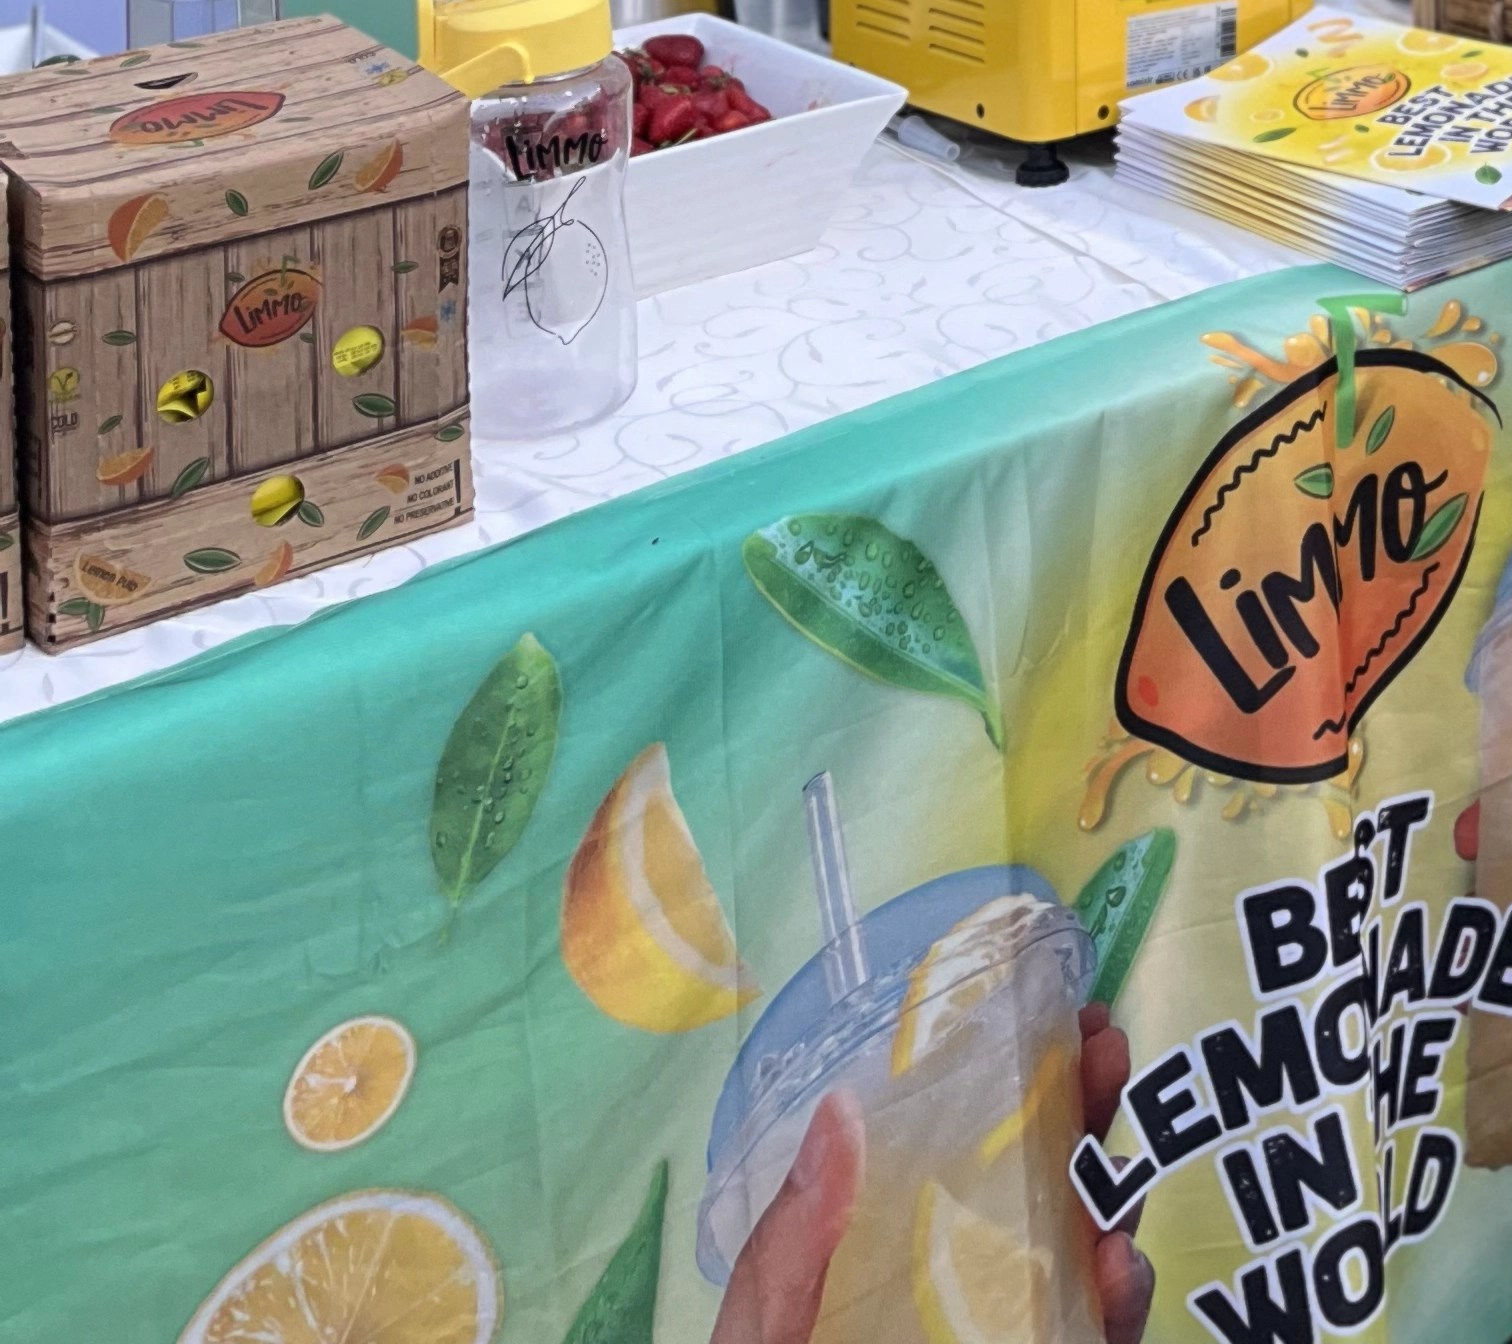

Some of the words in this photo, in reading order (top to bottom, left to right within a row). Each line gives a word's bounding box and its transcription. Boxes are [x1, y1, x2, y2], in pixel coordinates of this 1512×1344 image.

[1376, 85, 1454, 126] BEST
[1438, 125, 1482, 143] IN
[1222, 1111, 1358, 1246] IN
